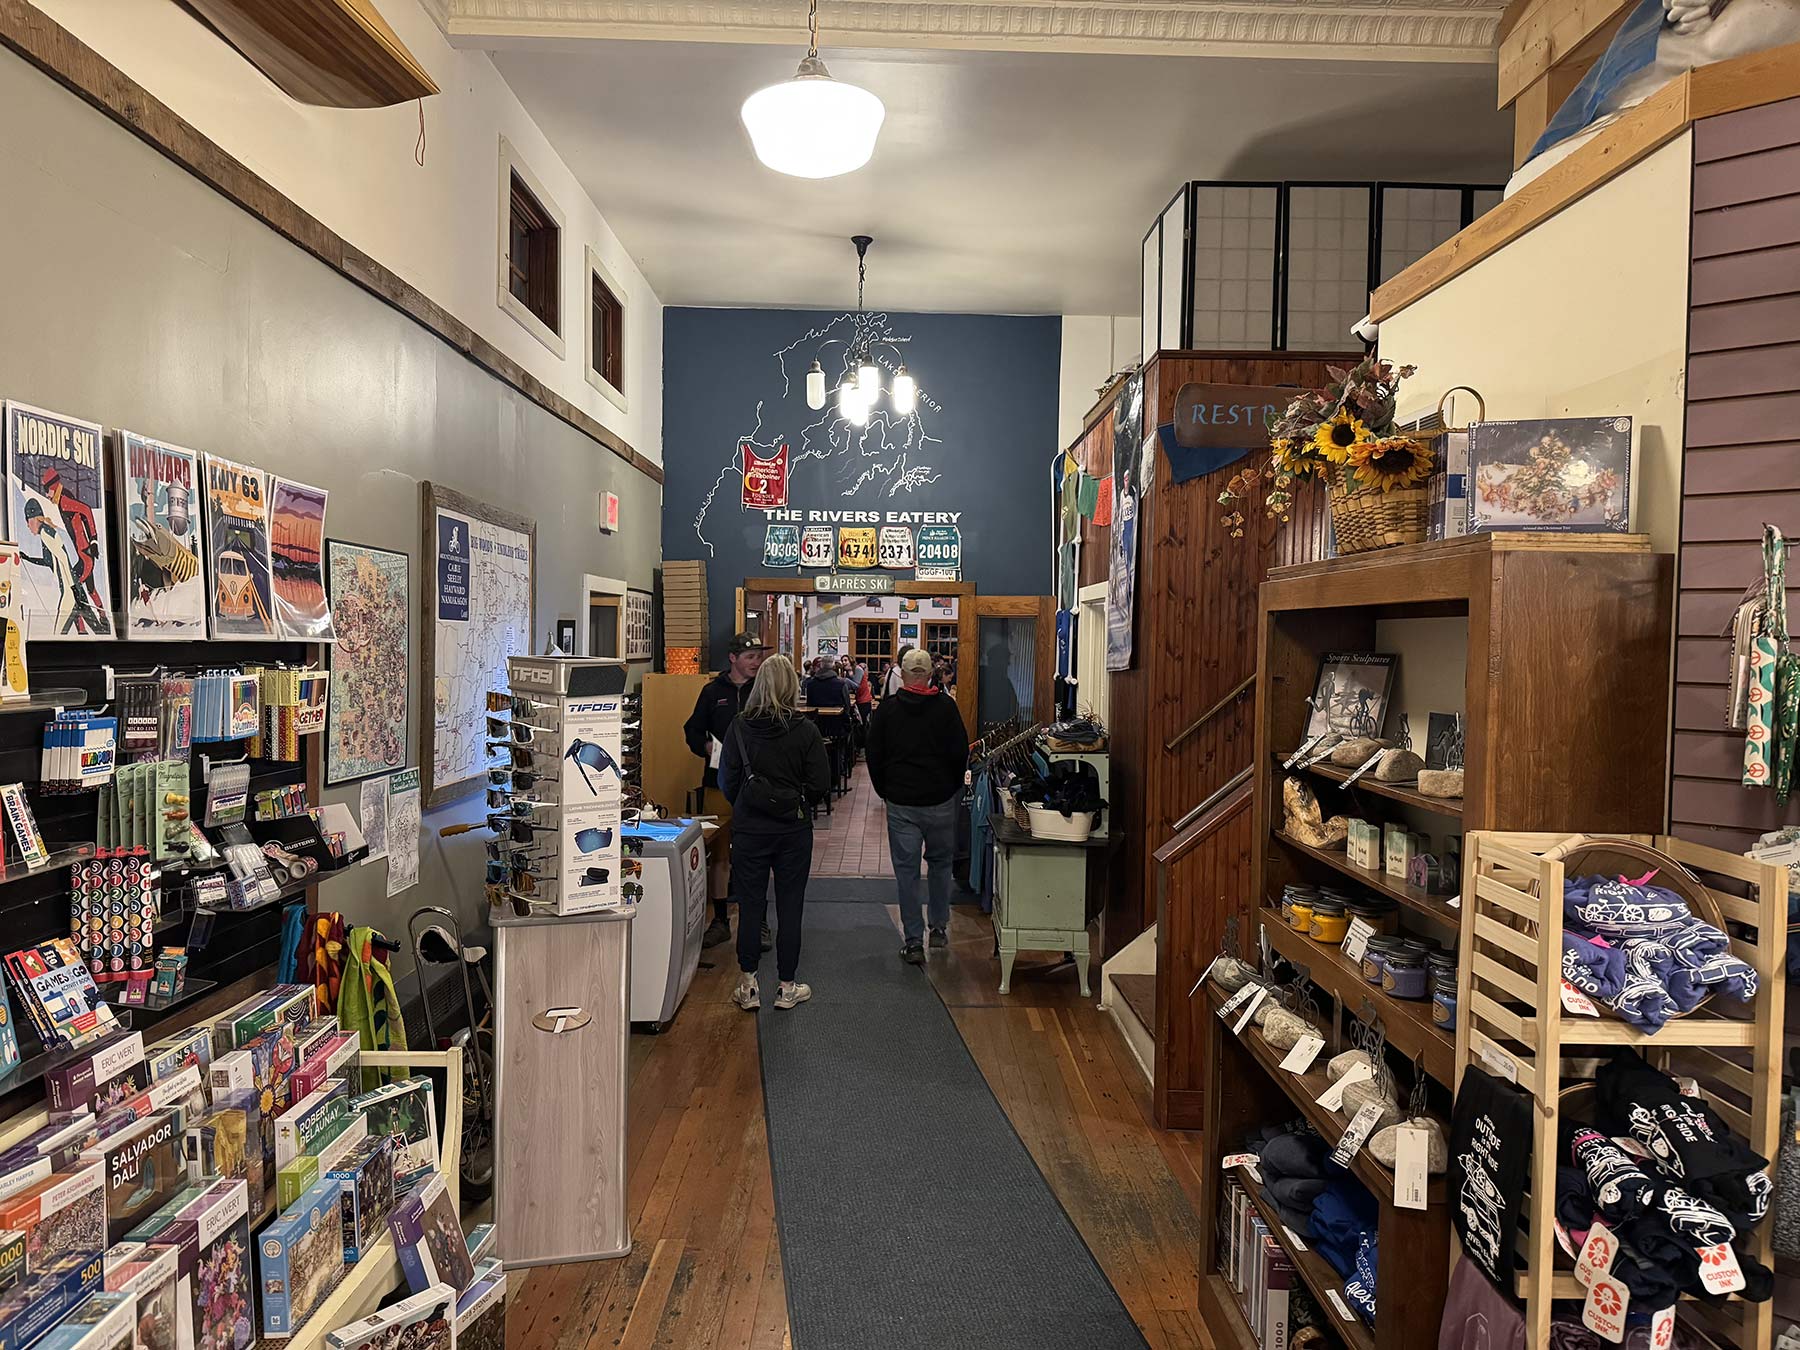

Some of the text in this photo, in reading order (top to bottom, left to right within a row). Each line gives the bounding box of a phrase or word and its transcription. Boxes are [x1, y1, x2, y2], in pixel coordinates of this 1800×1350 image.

[878, 355, 900, 376] LAKE
[1191, 403, 1277, 426] RESTR
[17, 415, 96, 470] NORDIC SKI
[129, 443, 191, 490] HAYWARD
[209, 464, 259, 501] HWY 63
[760, 479, 768, 494] 2
[763, 509, 962, 524] THE RIVERS EATERY
[765, 542, 798, 557] 20303
[806, 544, 831, 558] 317
[840, 543, 875, 559] 14741
[880, 545, 912, 559] 2371
[919, 544, 958, 559] 20408
[870, 576, 888, 590] SKI
[1327, 652, 1391, 664] Sports Sculptures
[513, 665, 552, 685] TIFOSI
[568, 703, 618, 713] TIFOSI
[6, 795, 32, 852] BRAIN GAMES
[36, 966, 87, 992] GAMES GO
[101, 1043, 136, 1070] ERIC WERT
[299, 1101, 330, 1134] ROBERT
[300, 1105, 340, 1148] DELAUNAY
[1676, 1122, 1698, 1143] SIDE
[112, 1123, 172, 1172] SALVADOR
[205, 1194, 242, 1232] ERIC WERT
[80, 1258, 101, 1286] 500
[1706, 1269, 1739, 1282] CUSTOM
[1719, 1281, 1735, 1289] INK
[1587, 1309, 1621, 1335] CUSTOM
[1594, 1322, 1609, 1336] INK
[1275, 1321, 1284, 1349] 1000
